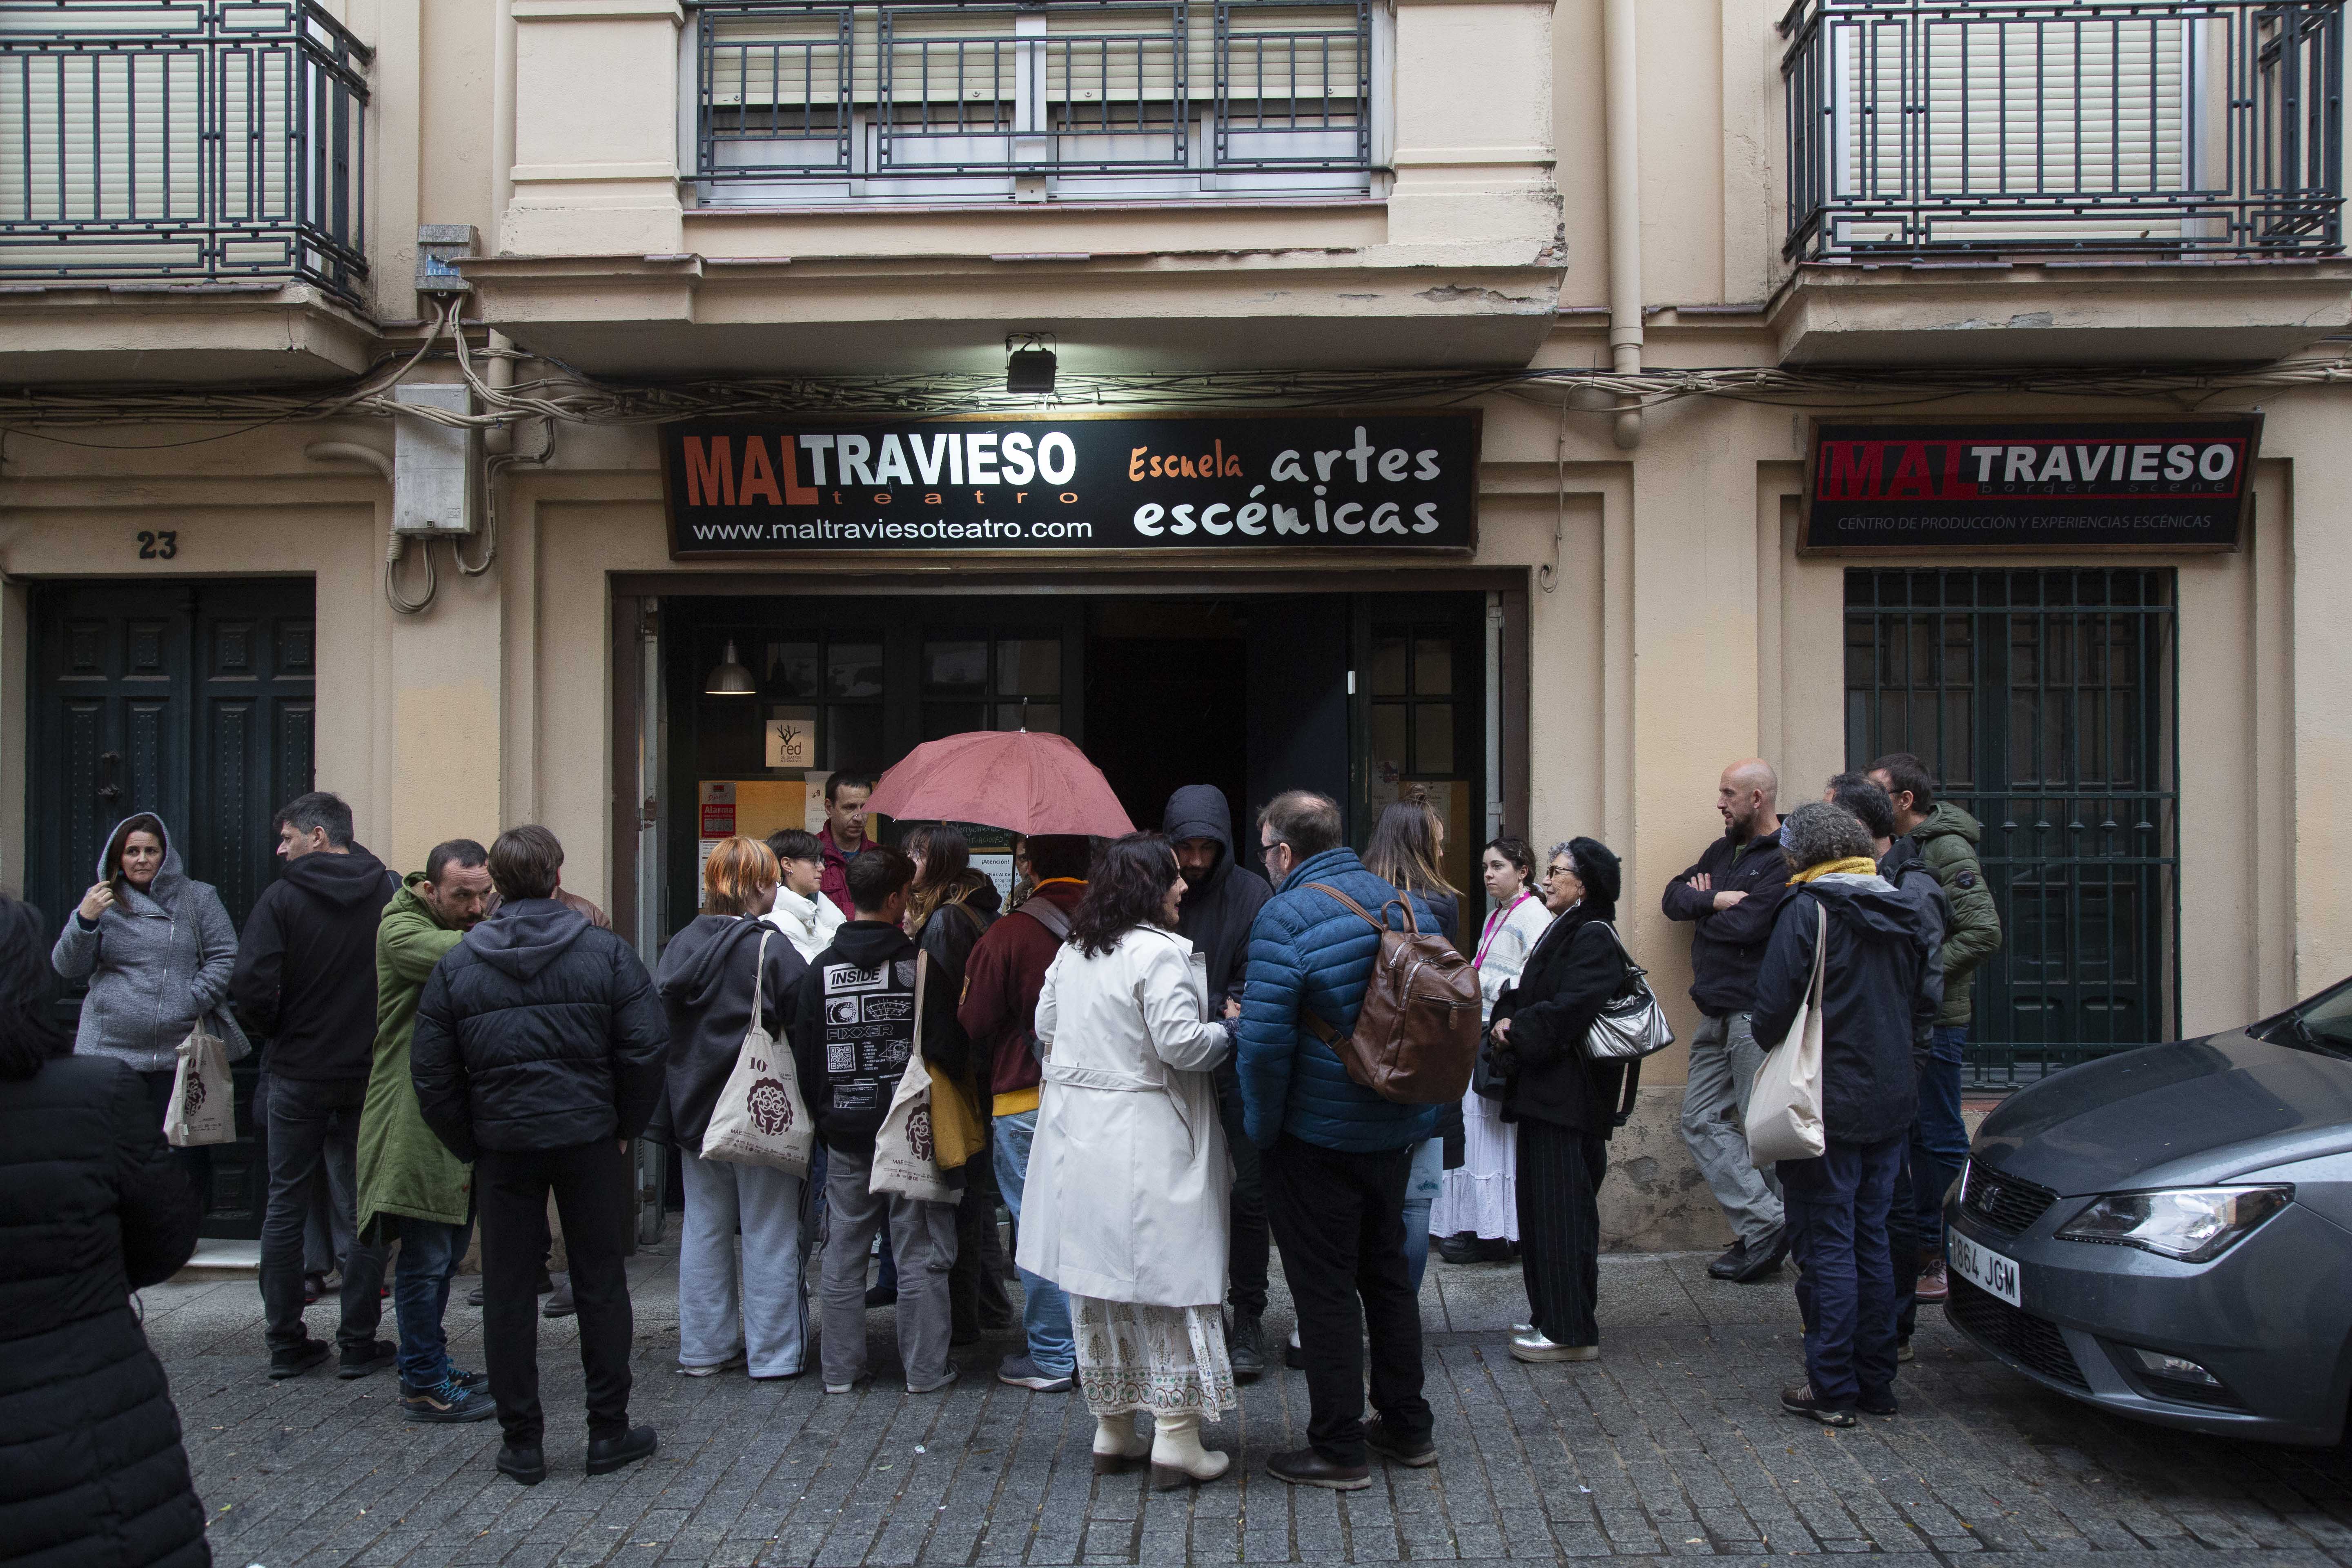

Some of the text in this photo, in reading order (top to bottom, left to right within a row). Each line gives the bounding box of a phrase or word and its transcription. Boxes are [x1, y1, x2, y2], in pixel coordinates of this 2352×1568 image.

[1129, 426, 1440, 483] Escuela artes
[683, 432, 1076, 506] MALTRAVIESO
[1829, 441, 2234, 500] MALTRAVIESO
[2129, 483, 2225, 492] scene
[833, 490, 1078, 505] teatro
[1134, 485, 1439, 536] escénicas
[693, 519, 1092, 539] www.maltraviesoteatro.com
[1838, 514, 2211, 530] CENTRO DE PRODUCCIÓN Y EXPERIENCIAS ESCÉNICAS
[137, 531, 176, 559] 23
[781, 742, 801, 755] red
[704, 806, 733, 814] Alarma
[831, 968, 880, 985] INSIDE
[827, 1024, 893, 1040] FIXXER
[1952, 1234, 2015, 1298] 1864 JGM
